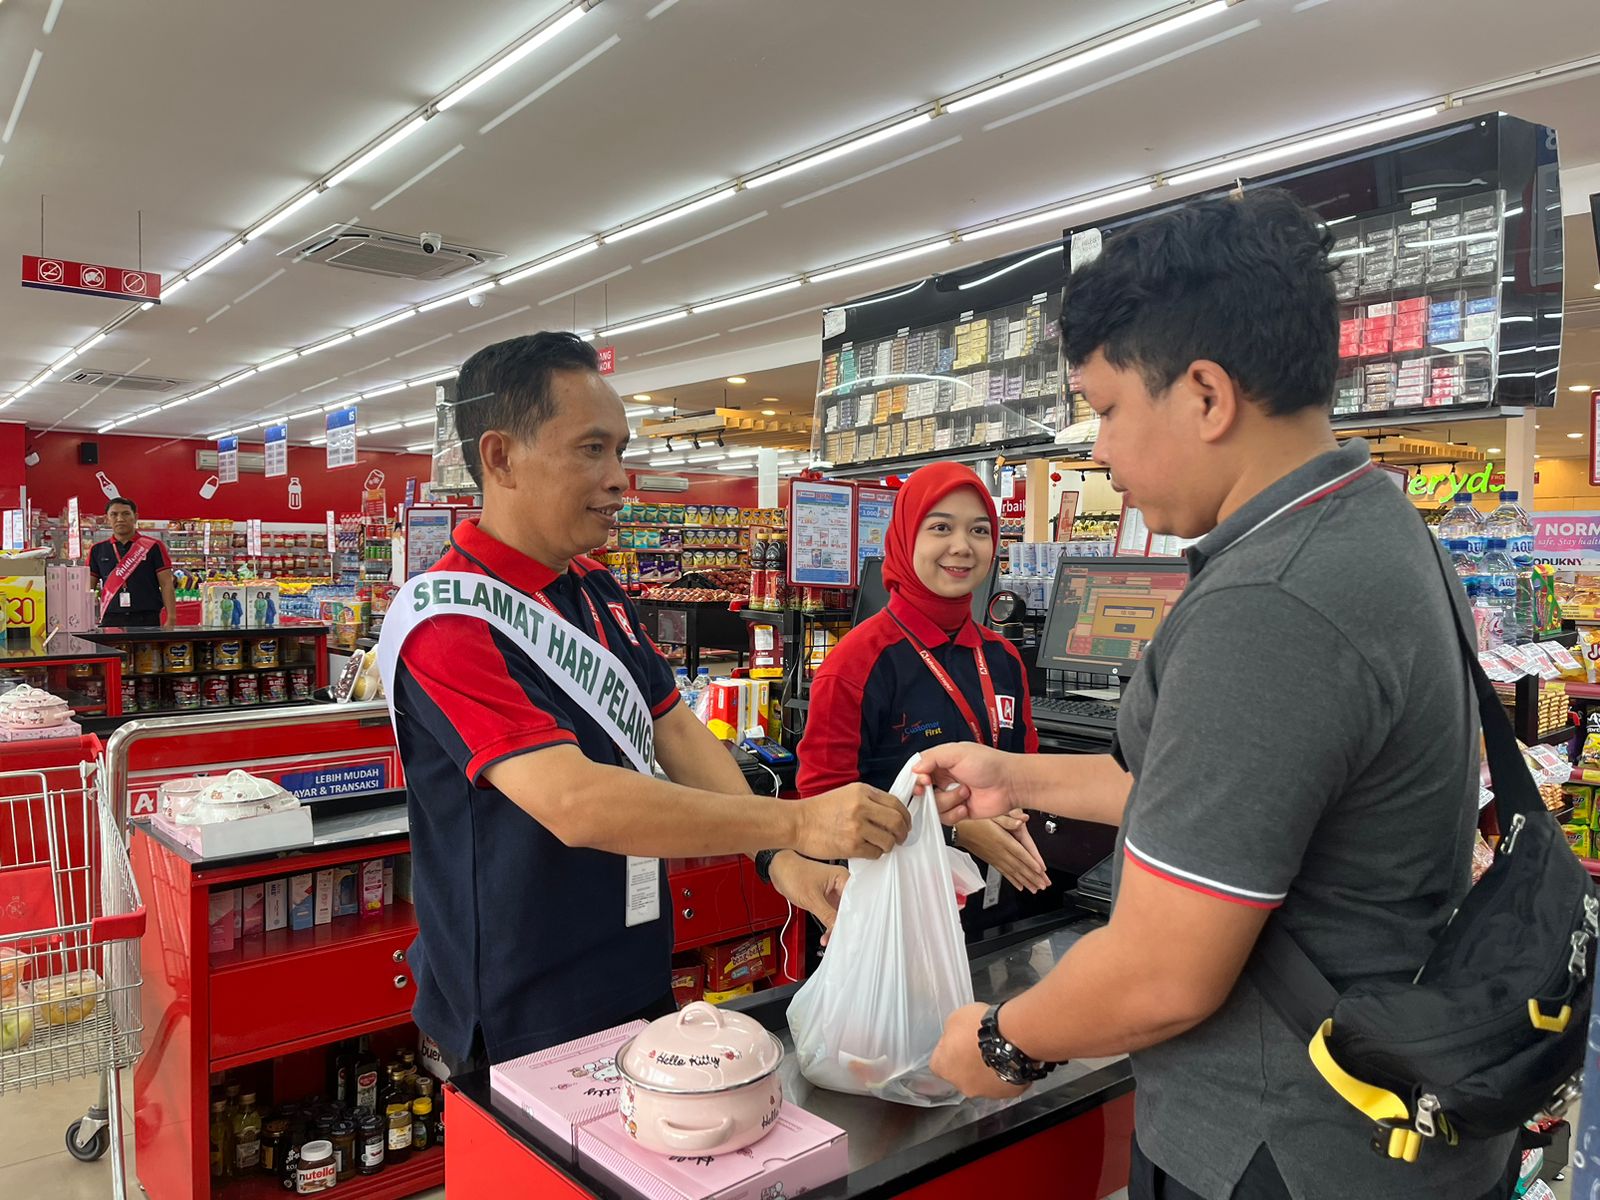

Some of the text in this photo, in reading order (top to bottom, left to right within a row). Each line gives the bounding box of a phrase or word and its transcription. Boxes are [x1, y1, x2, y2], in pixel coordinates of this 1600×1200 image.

[1557, 537, 1577, 546] Stay
[413, 579, 544, 645] SELAMAT
[547, 622, 602, 695] HARI
[924, 727, 943, 737] First
[315, 768, 379, 785] LEBIH MUDAH
[319, 786, 328, 795] &
[329, 780, 379, 794] TRANSAKSI
[656, 1051, 720, 1069] Hello Kitty
[299, 1167, 335, 1181] nutella
